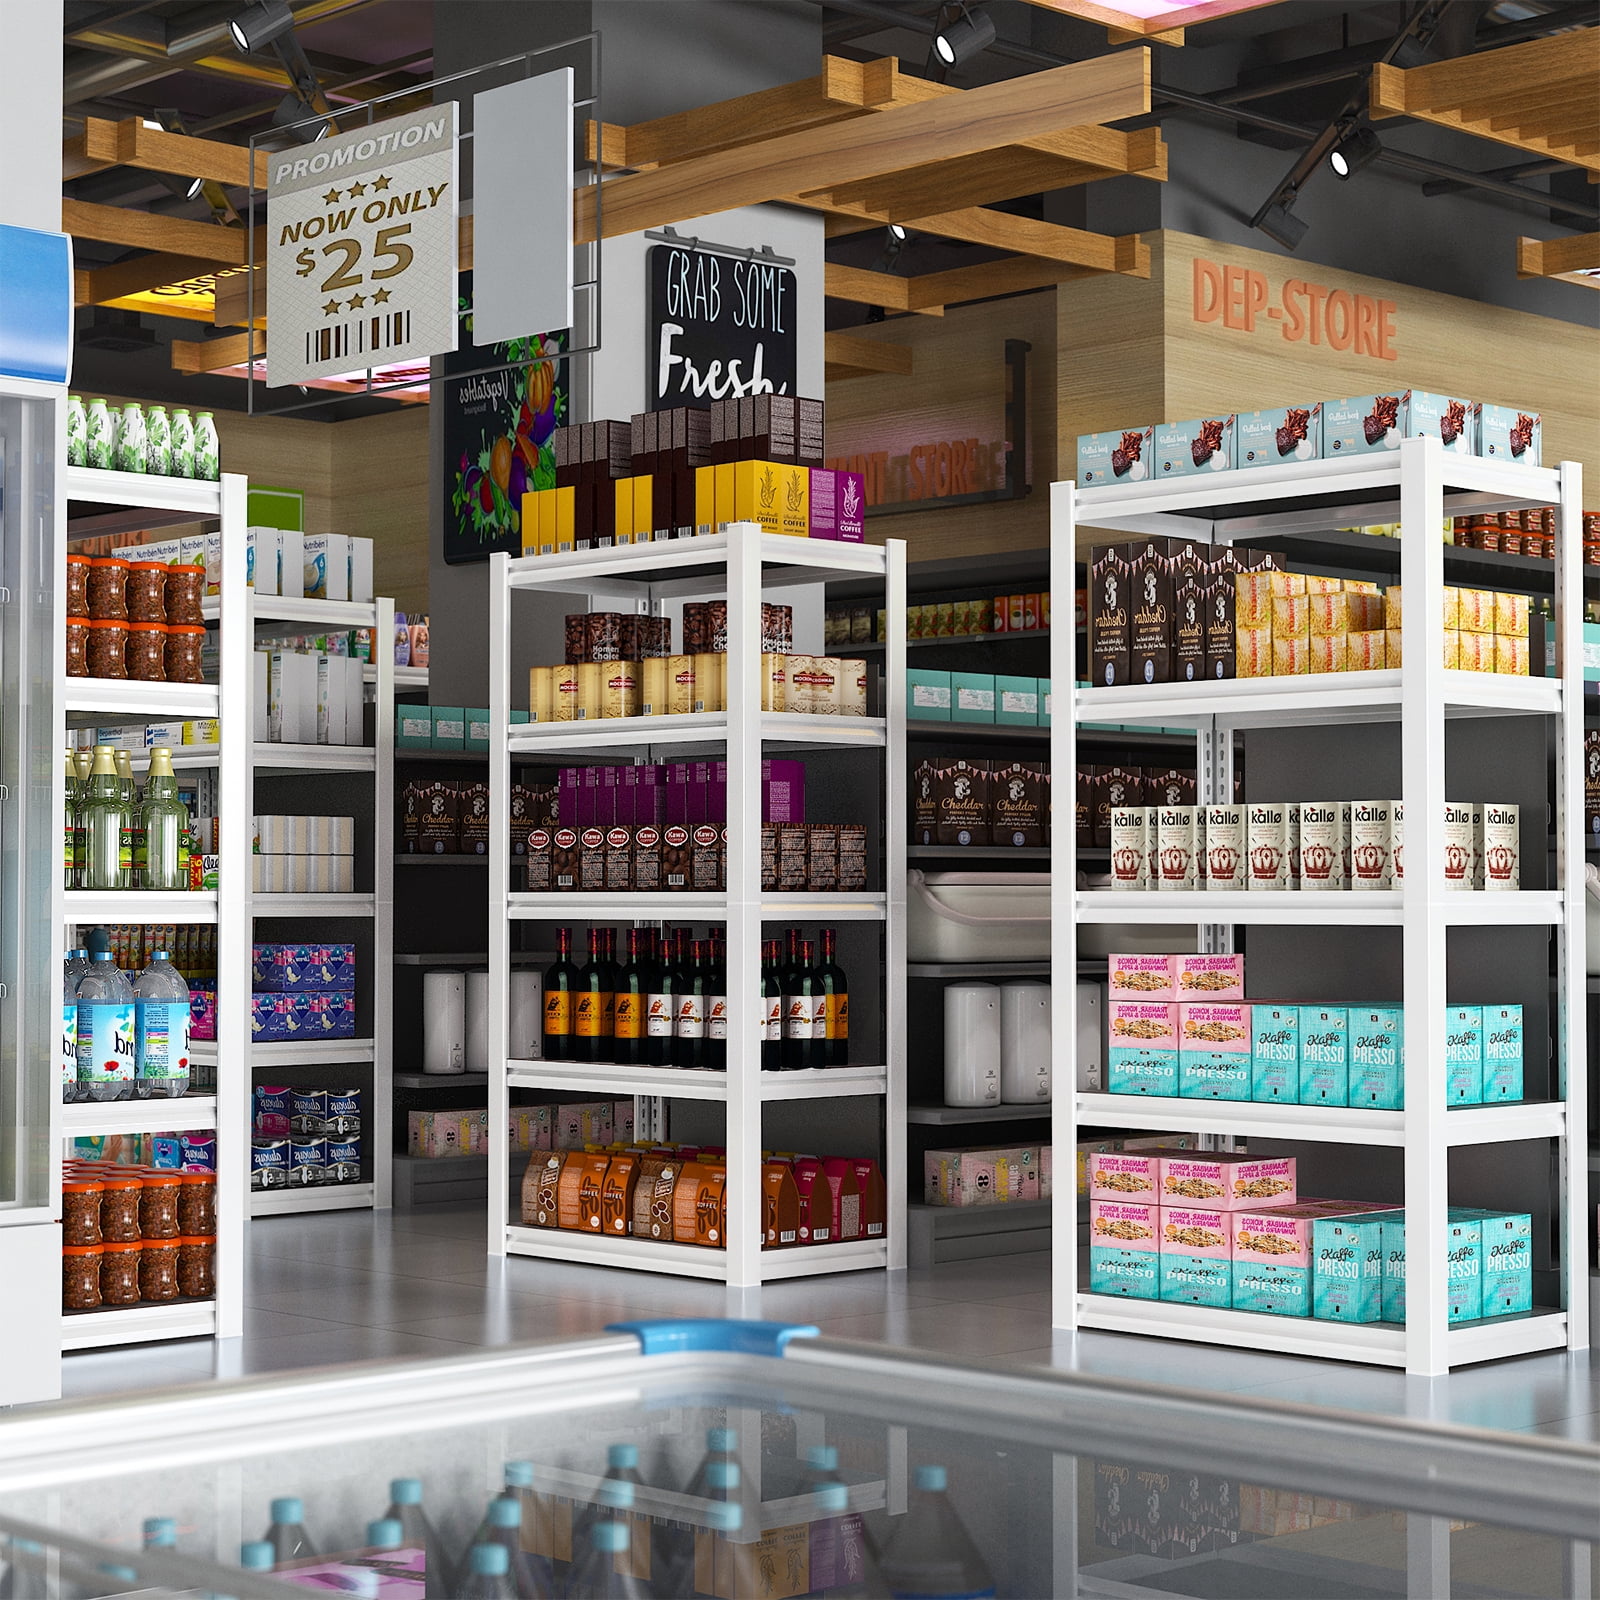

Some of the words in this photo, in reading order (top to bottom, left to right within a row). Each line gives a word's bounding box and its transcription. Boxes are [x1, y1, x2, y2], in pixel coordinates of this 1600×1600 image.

[275, 118, 446, 185] PROMOTION
[279, 206, 358, 247] NOW
[362, 182, 449, 226] ONLY
[295, 223, 414, 293] $25
[667, 250, 721, 322] GRAB
[733, 261, 787, 333] SOME
[1193, 257, 1397, 361] DEP-STORE
[840, 526, 862, 534] COFFEE
[941, 798, 984, 809] Cheddar
[996, 799, 1038, 811] Cheddar
[1445, 810, 1469, 823] allø
[1259, 1031, 1292, 1045] Kaffe
[1306, 1032, 1340, 1047] Kaffe
[1357, 1034, 1391, 1048] Kaffe
[1490, 1029, 1518, 1044] Kaffe
[1256, 1043, 1296, 1060] PRESSO
[1304, 1045, 1344, 1063] PRESSO
[1353, 1047, 1395, 1065] PRESSO
[1487, 1042, 1521, 1059] PRESSO
[1115, 1065, 1174, 1076] PRESSO
[1186, 1068, 1247, 1080] PRESSO
[1320, 1248, 1355, 1262] Kaffe
[1491, 1240, 1525, 1257] Kaffe
[1317, 1258, 1359, 1279] PRESSO
[1487, 1252, 1530, 1272] PRESSO
[1096, 1265, 1154, 1279] PRESSO
[1166, 1272, 1226, 1287] PRESSO
[1239, 1280, 1302, 1295] PRESSO
